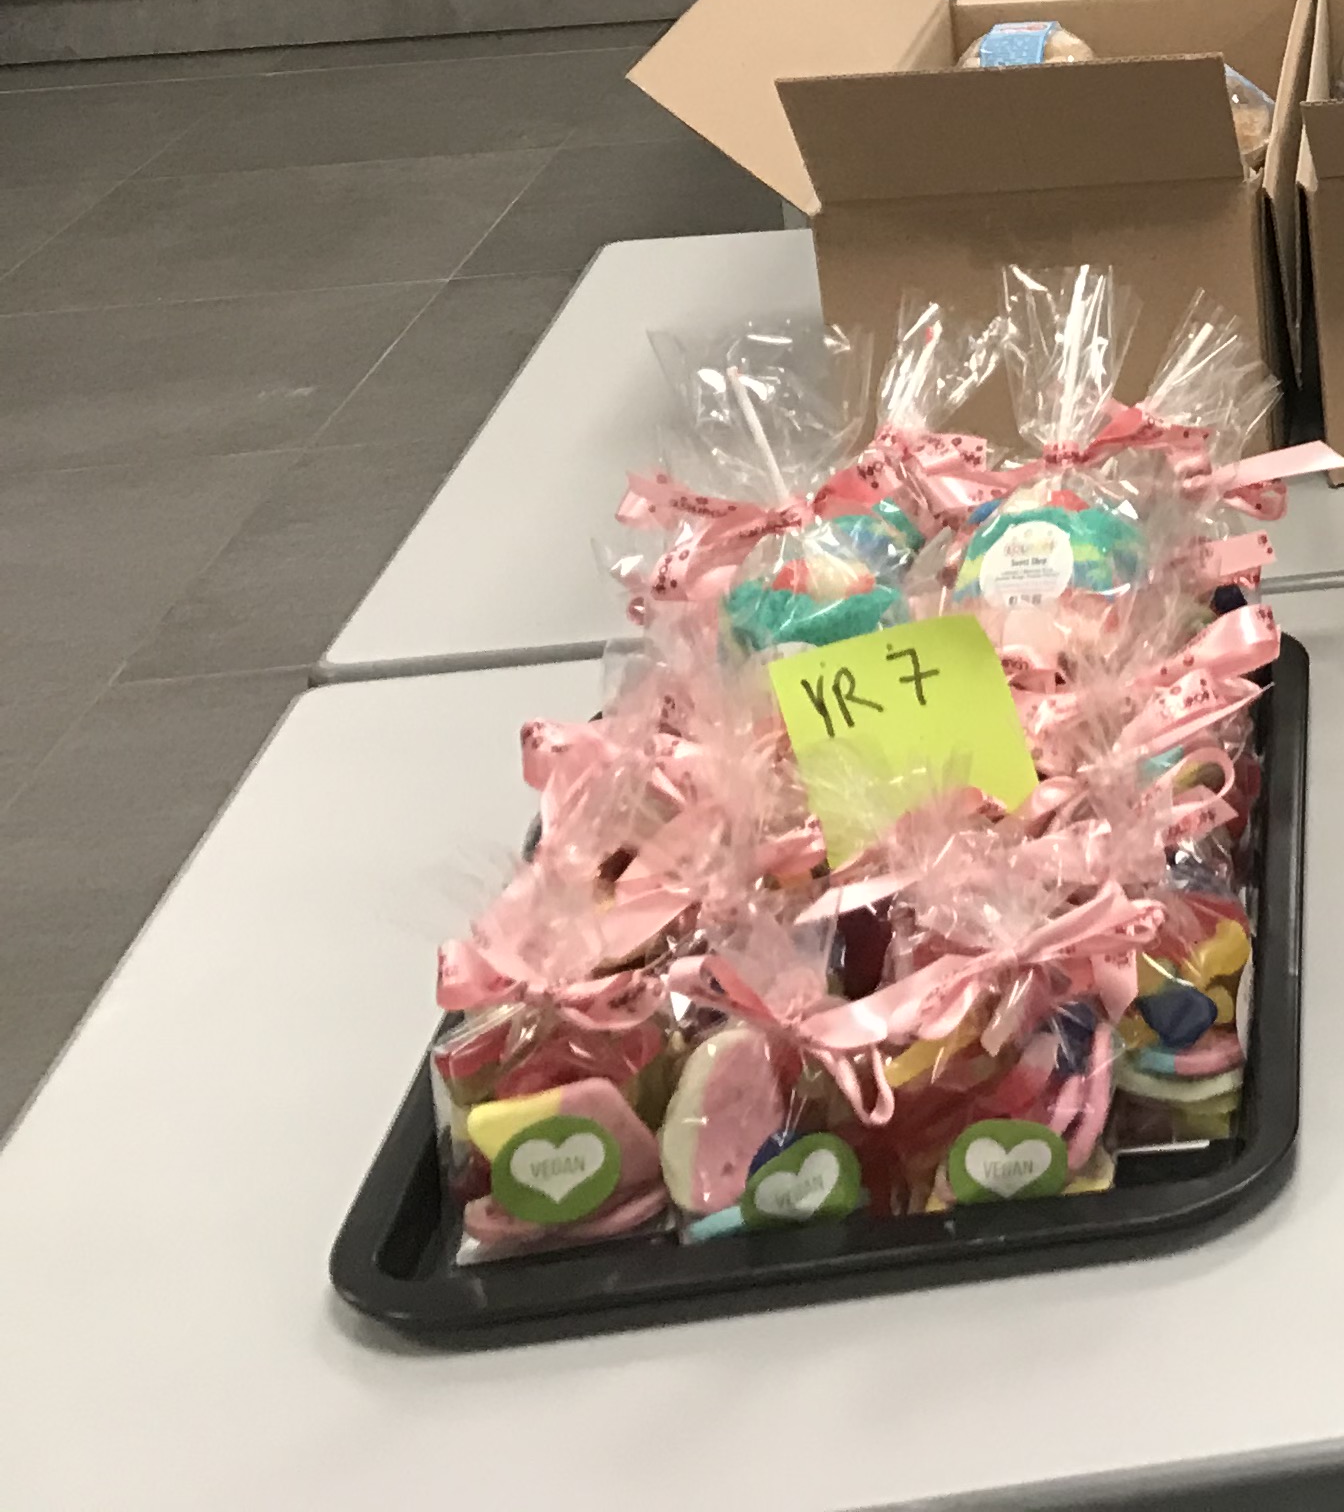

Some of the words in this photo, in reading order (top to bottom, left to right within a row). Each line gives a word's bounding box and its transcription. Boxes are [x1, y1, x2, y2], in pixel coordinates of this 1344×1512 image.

[801, 667, 883, 737] YR
[886, 643, 940, 705] 7
[530, 1156, 585, 1178] VEGAN
[983, 1160, 1033, 1178] VEGAN
